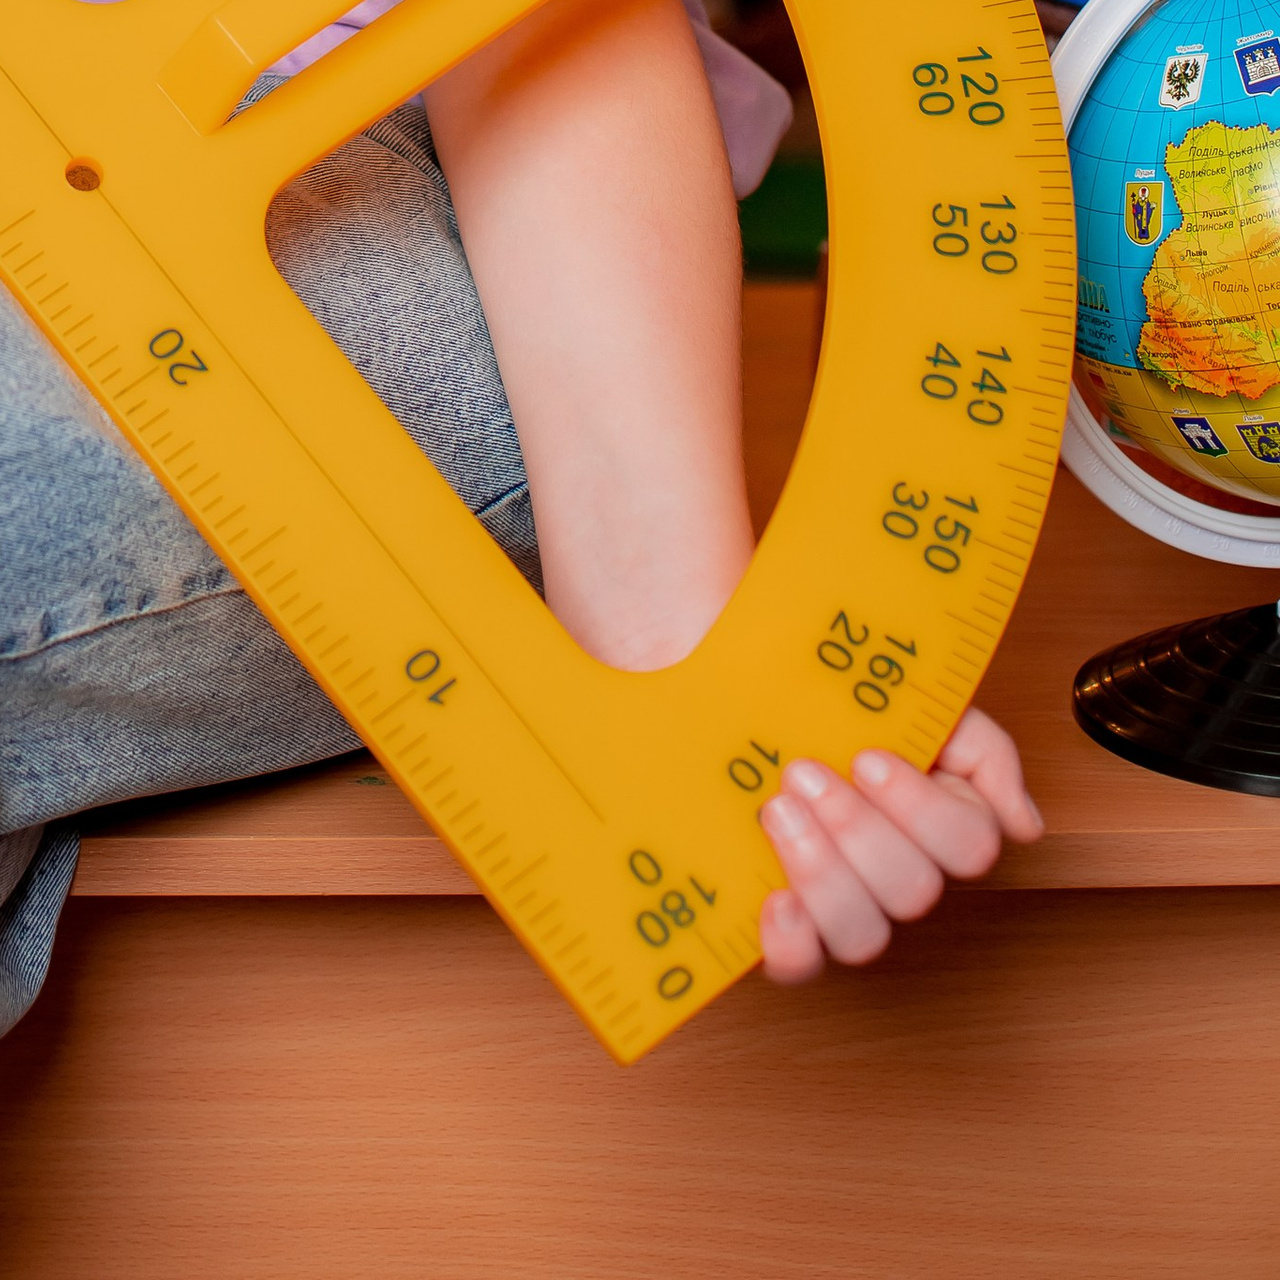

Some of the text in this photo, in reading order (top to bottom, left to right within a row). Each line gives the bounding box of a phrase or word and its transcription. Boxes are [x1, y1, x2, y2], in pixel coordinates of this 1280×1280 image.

[913, 63, 955, 116] 60
[957, 47, 1005, 126] 120
[1179, 166, 1227, 180] Волинське
[1233, 161, 1263, 178] пасмо
[932, 203, 969, 257] 50
[980, 195, 1017, 275] 130
[1186, 220, 1234, 233] Волинська
[1202, 210, 1228, 219] Луцьк
[1185, 249, 1208, 257] Львів
[1213, 280, 1249, 293] Поділь
[149, 329, 208, 386] 20
[921, 343, 961, 400] 40
[967, 347, 1011, 426] 140
[883, 482, 929, 539] 30
[924, 493, 978, 573] 150
[818, 611, 869, 672] 20
[406, 650, 456, 704] 10
[853, 632, 916, 712] 160
[729, 742, 779, 792] 10
[629, 851, 662, 885] 0
[629, 851, 662, 885] 180
[635, 876, 715, 947] 0
